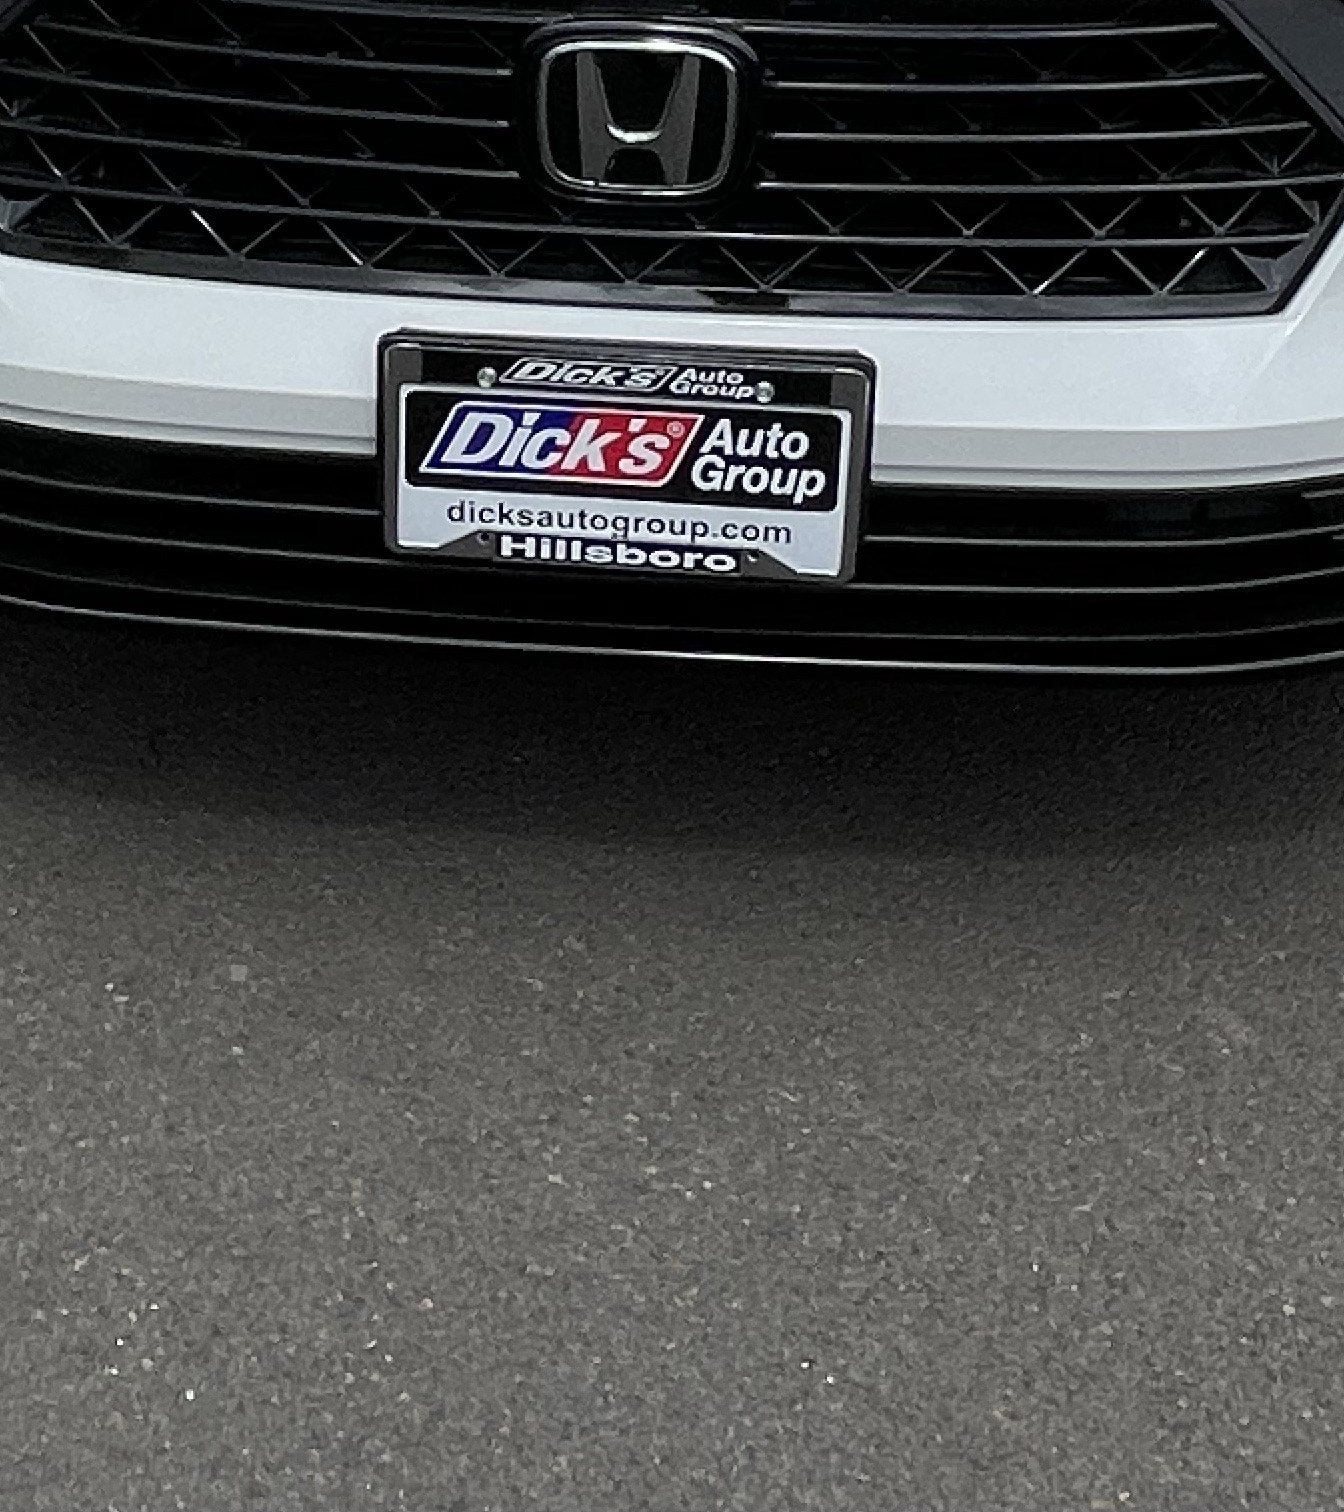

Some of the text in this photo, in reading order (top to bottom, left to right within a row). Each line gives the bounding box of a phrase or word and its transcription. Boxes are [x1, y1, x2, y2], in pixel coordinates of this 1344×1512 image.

[669, 380, 755, 400] Group
[679, 368, 744, 385] Auto
[699, 418, 810, 460] Auto
[691, 454, 826, 504] Group
[446, 499, 792, 544] dicksautogroup.com
[499, 535, 738, 573] Hillsboro
